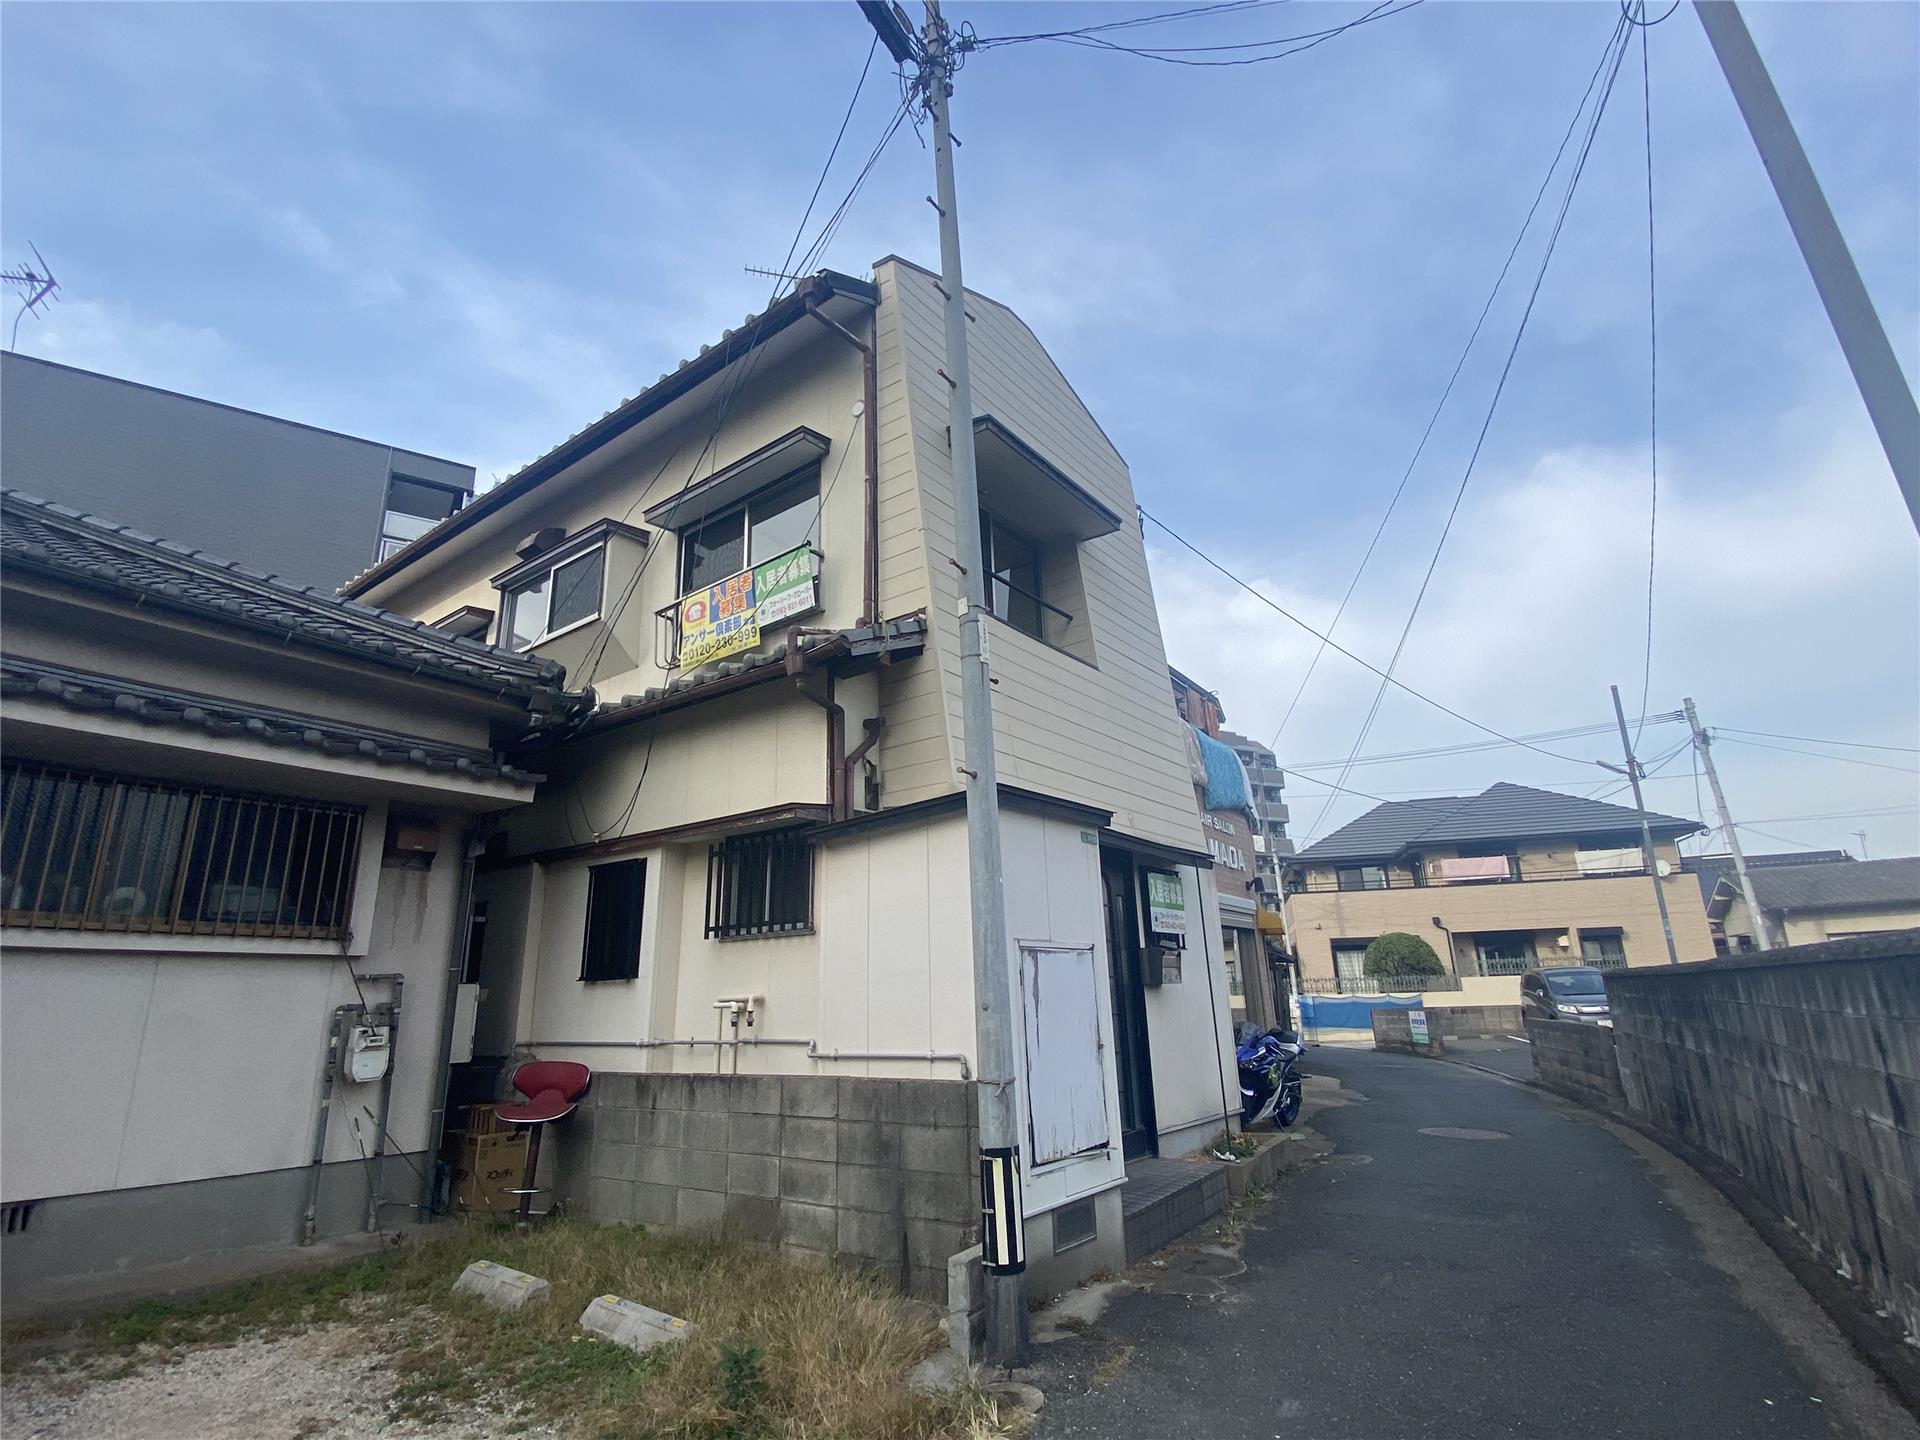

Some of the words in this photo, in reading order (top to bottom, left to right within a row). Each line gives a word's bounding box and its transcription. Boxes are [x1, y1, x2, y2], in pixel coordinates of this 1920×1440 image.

[712, 571, 753, 605] 入居者
[756, 554, 811, 595] 入居者募集
[719, 593, 746, 619] 募集
[1213, 817, 1235, 836] SALON
